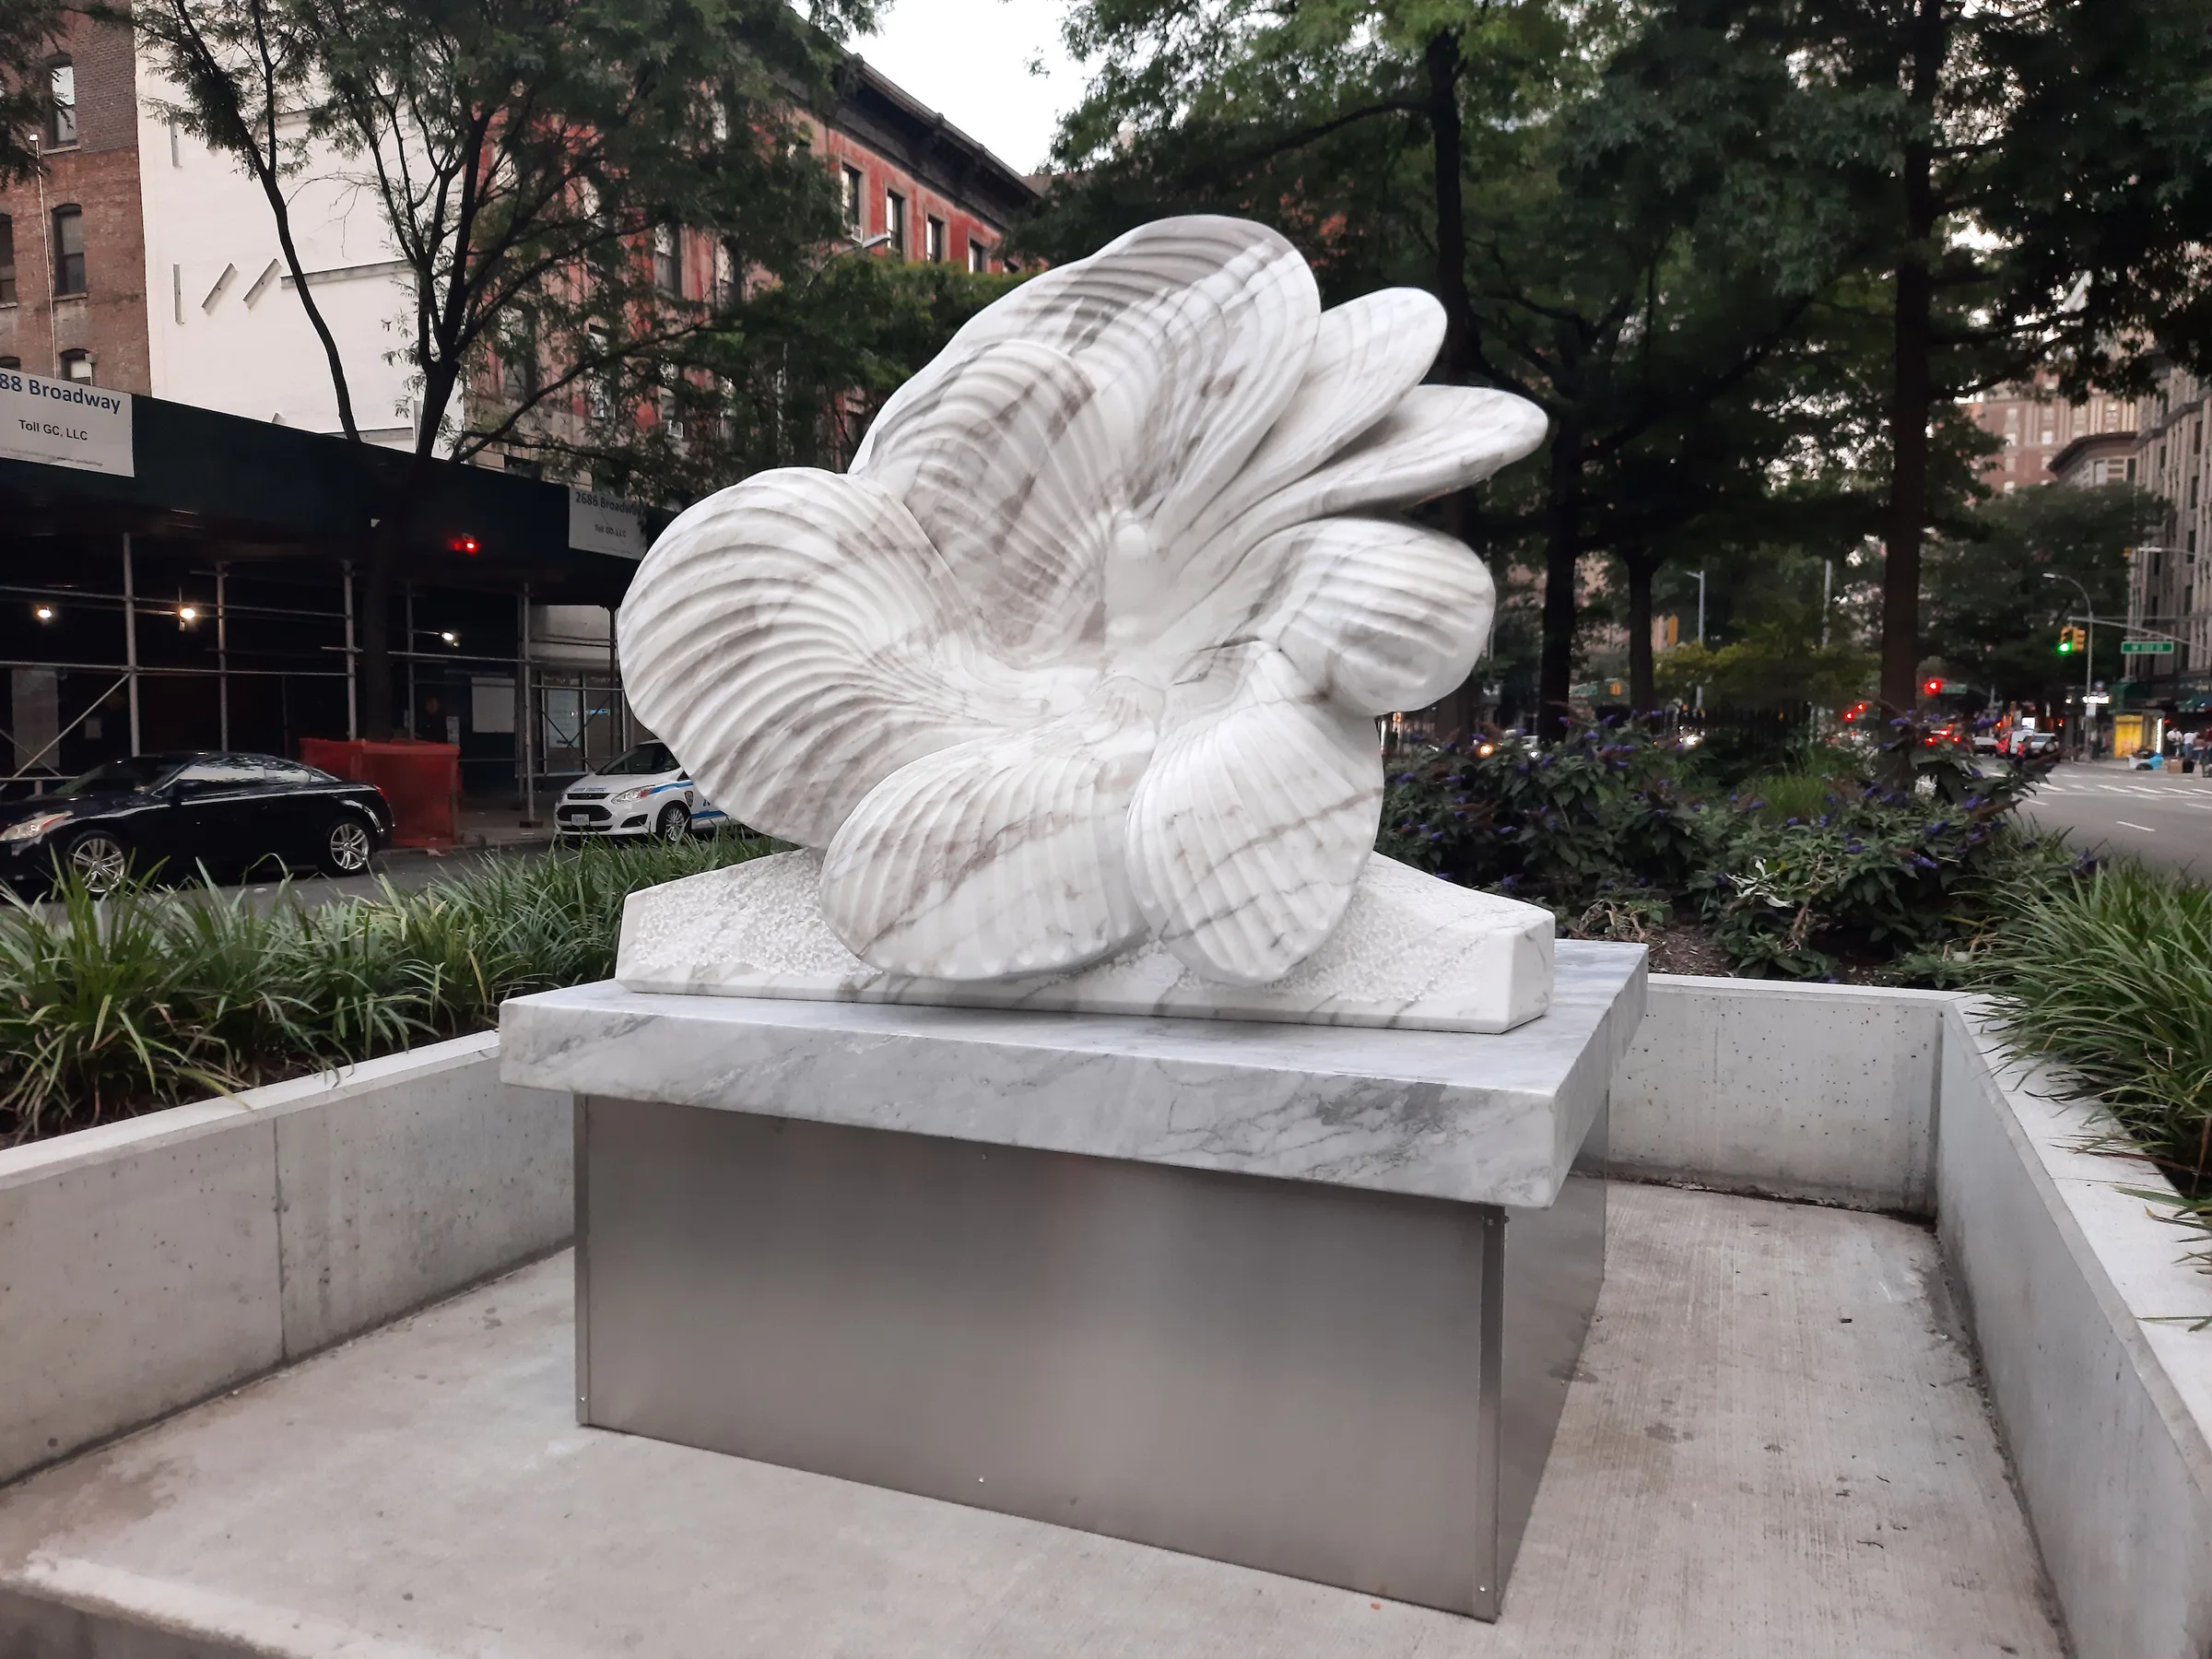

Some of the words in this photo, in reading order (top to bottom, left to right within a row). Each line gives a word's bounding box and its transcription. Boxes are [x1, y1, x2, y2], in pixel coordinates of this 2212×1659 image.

[29, 379, 121, 415] Broadway
[18, 419, 40, 432] Toll
[43, 424, 64, 438] GC,
[66, 429, 88, 441] LLC
[600, 497, 642, 517] Broadway
